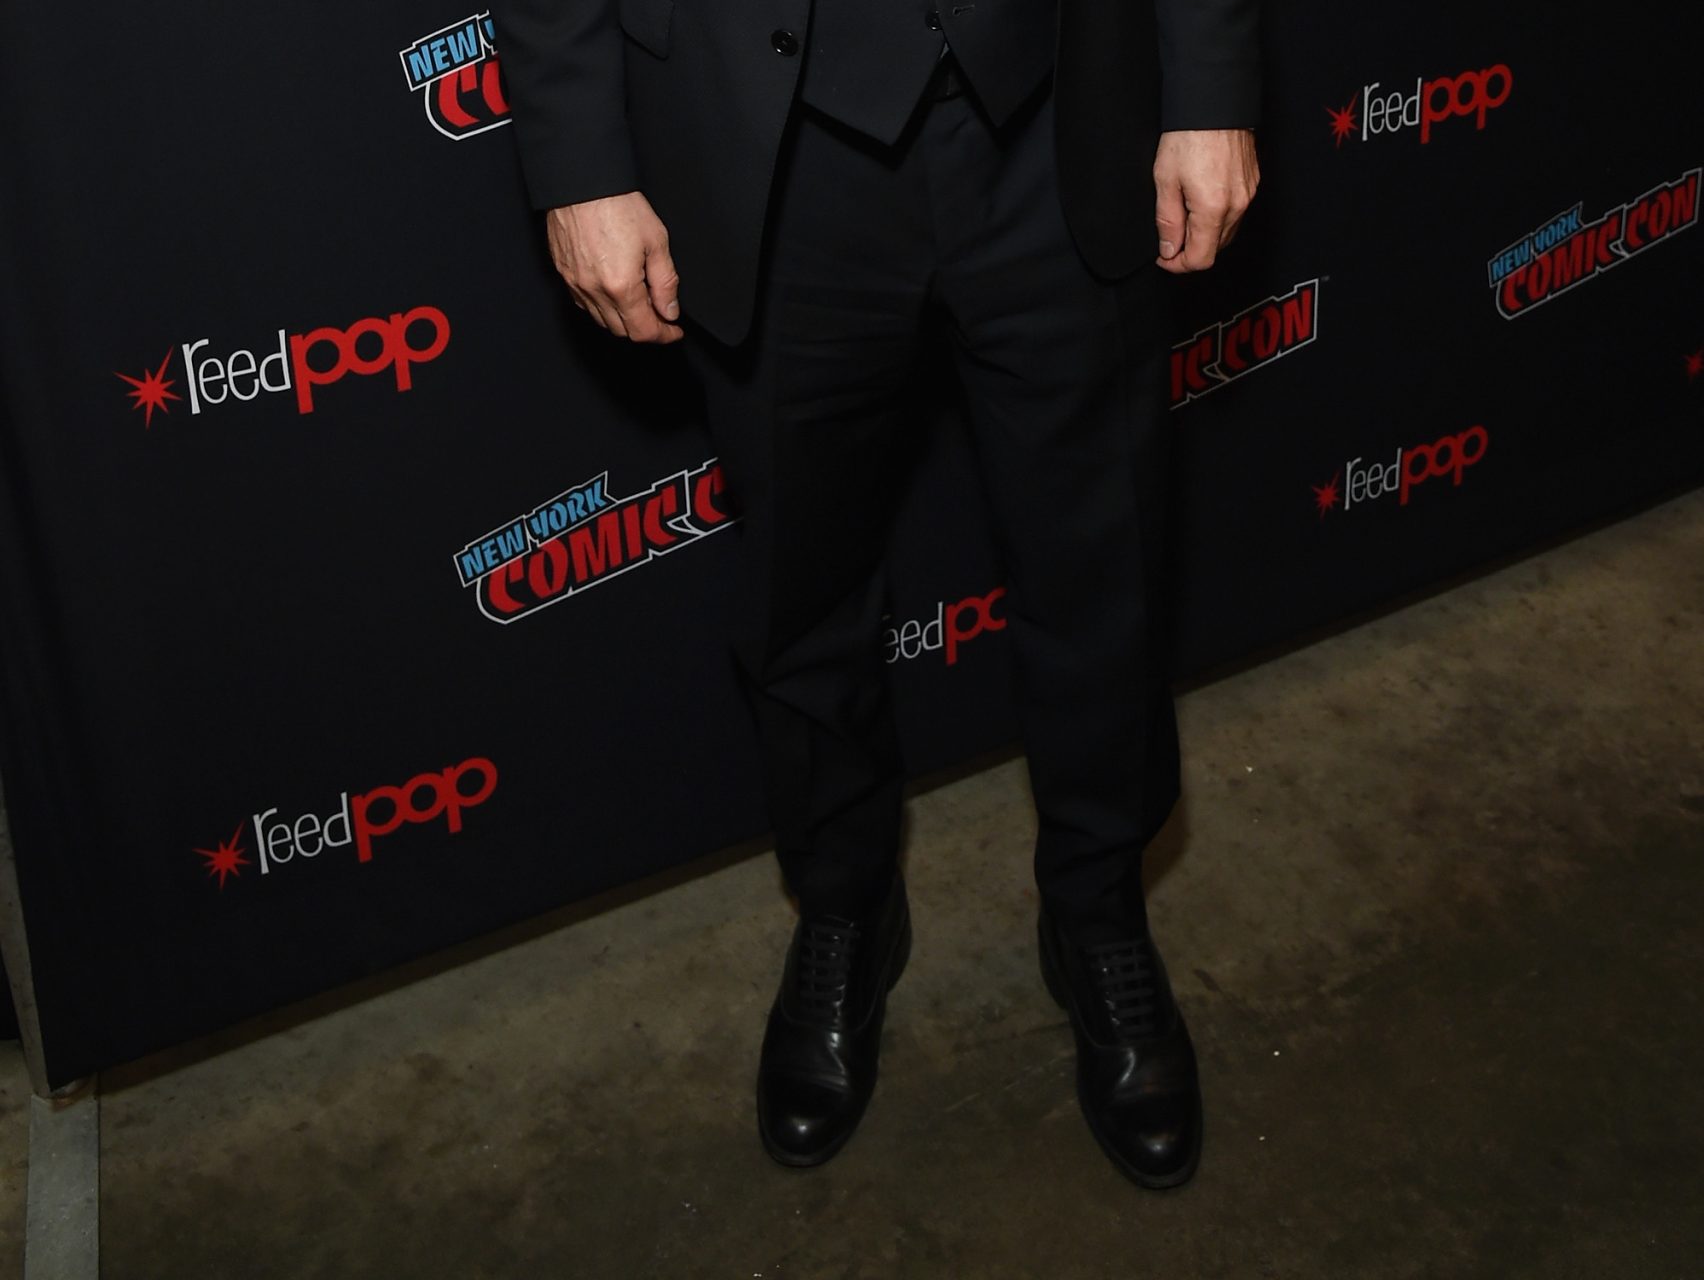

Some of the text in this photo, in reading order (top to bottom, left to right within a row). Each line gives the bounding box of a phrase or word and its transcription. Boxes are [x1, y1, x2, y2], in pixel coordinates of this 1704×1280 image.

[408, 24, 478, 81] NEW
[1491, 208, 1580, 281] NEW YORK
[1503, 176, 1696, 311] COMIC CON
[1225, 288, 1313, 371] CON
[461, 481, 607, 579] NEW YORK
[488, 485, 677, 613] COMIC
